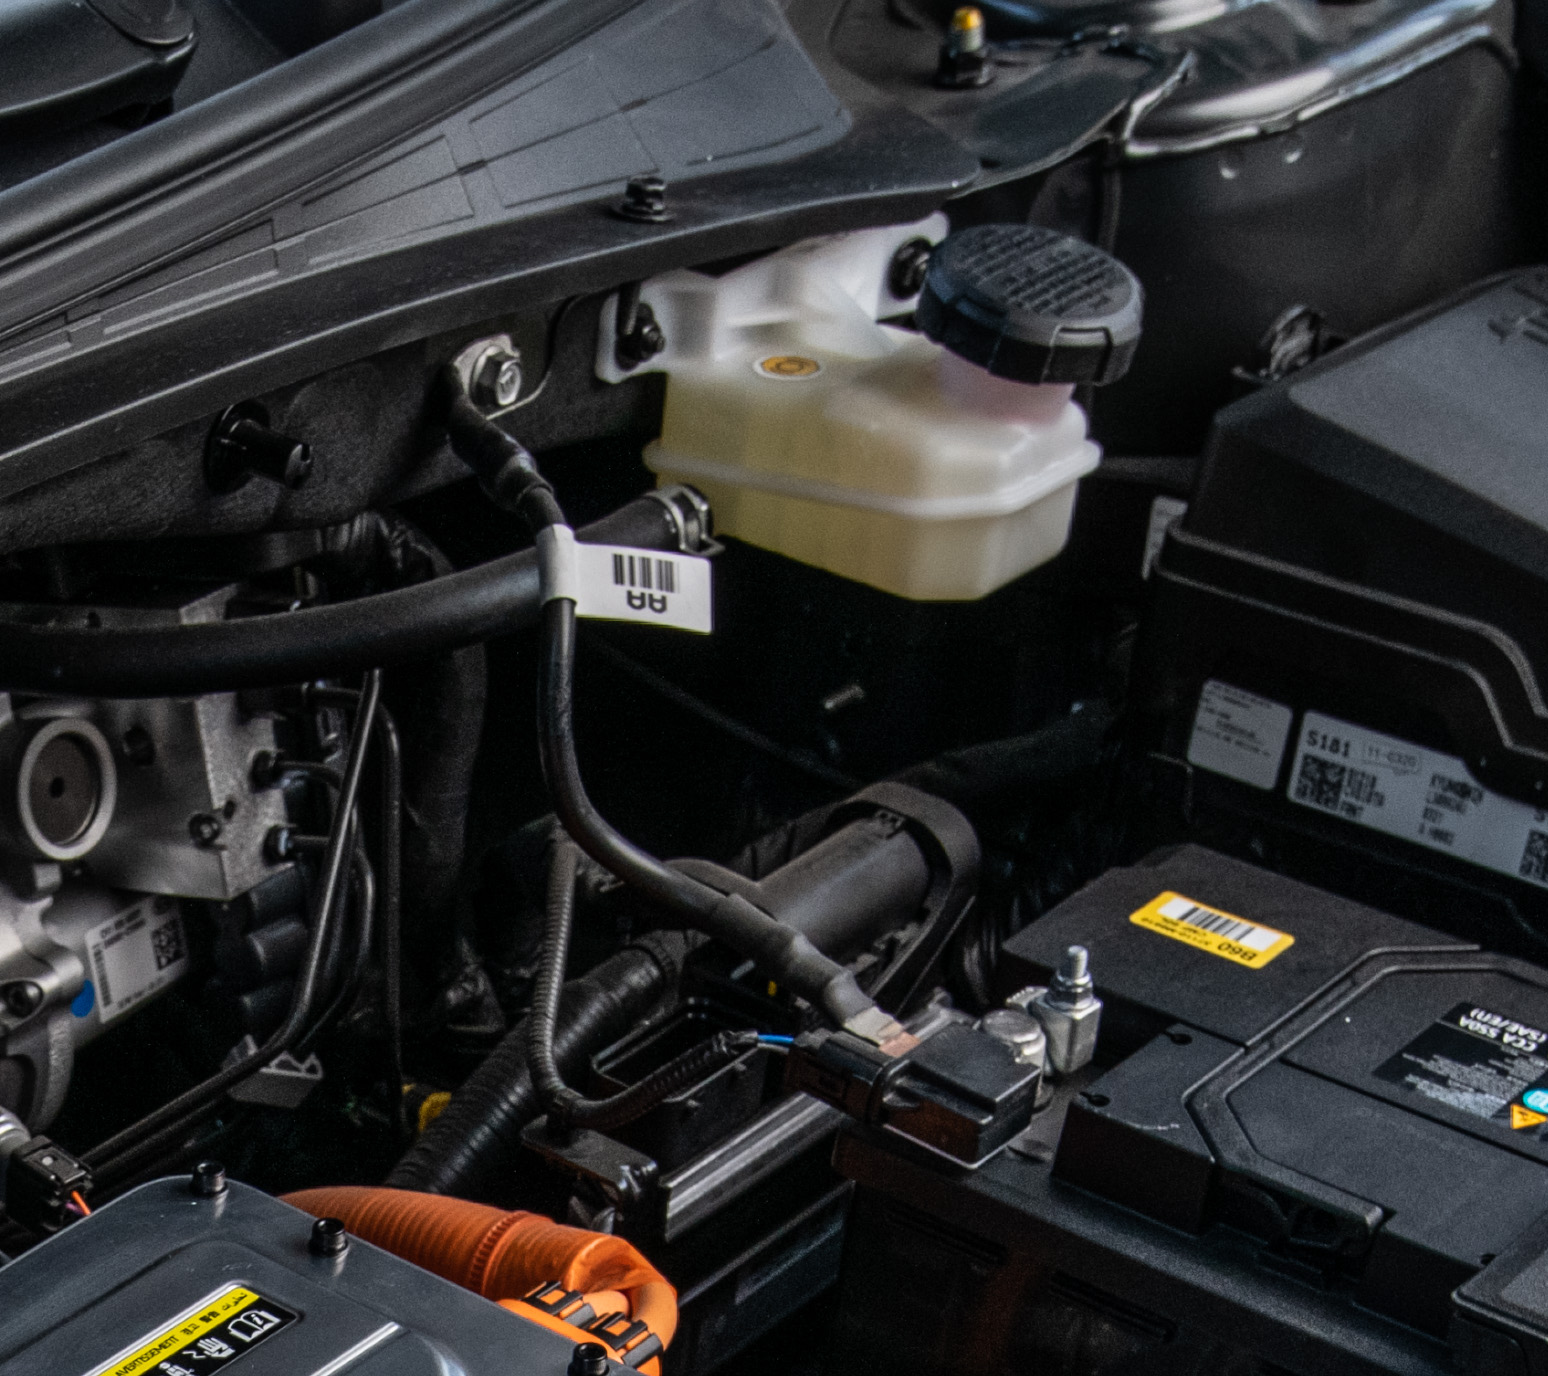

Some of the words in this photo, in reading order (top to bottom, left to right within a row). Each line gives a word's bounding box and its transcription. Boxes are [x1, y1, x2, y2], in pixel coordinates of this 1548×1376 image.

[1307, 729, 1351, 758] S181
[1217, 941, 1257, 962] B60
[1502, 1031, 1538, 1052] CCA
